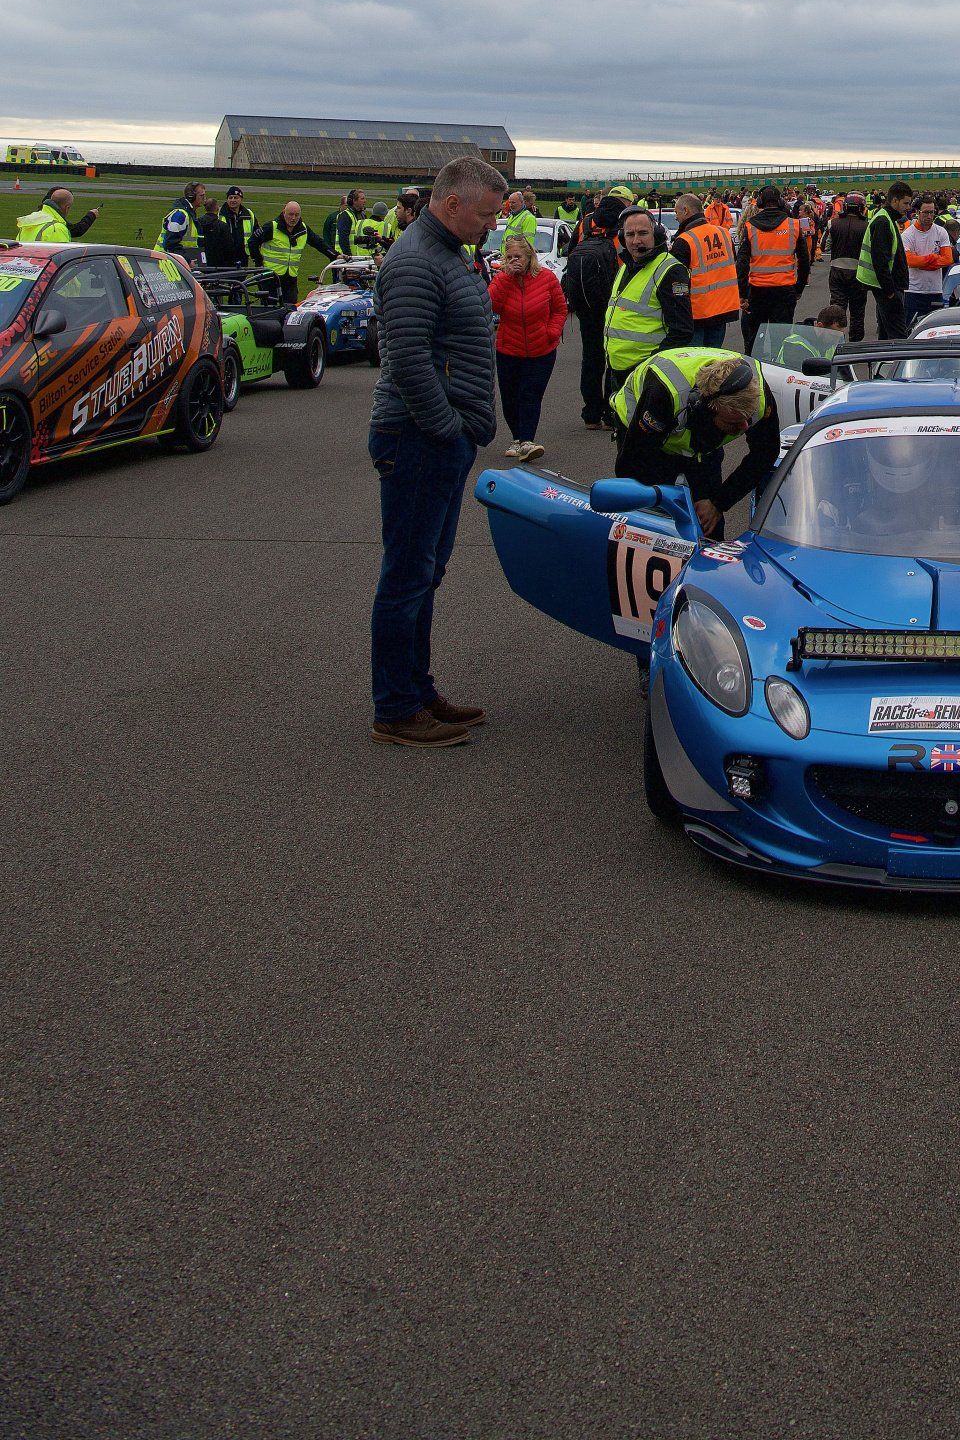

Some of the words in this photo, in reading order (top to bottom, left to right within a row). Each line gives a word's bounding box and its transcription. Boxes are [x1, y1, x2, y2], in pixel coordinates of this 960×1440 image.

[704, 233, 722, 251] 14
[706, 251, 725, 260] MEDIA
[39, 384, 69, 414] Bilton
[67, 358, 100, 391] Service
[99, 325, 126, 359] Station
[109, 340, 186, 417] motorsport
[917, 425, 936, 433] RACE
[558, 493, 583, 507] PETER
[583, 501, 629, 524] MFIELD
[625, 546, 671, 620] 19
[873, 705, 910, 720] RACE
